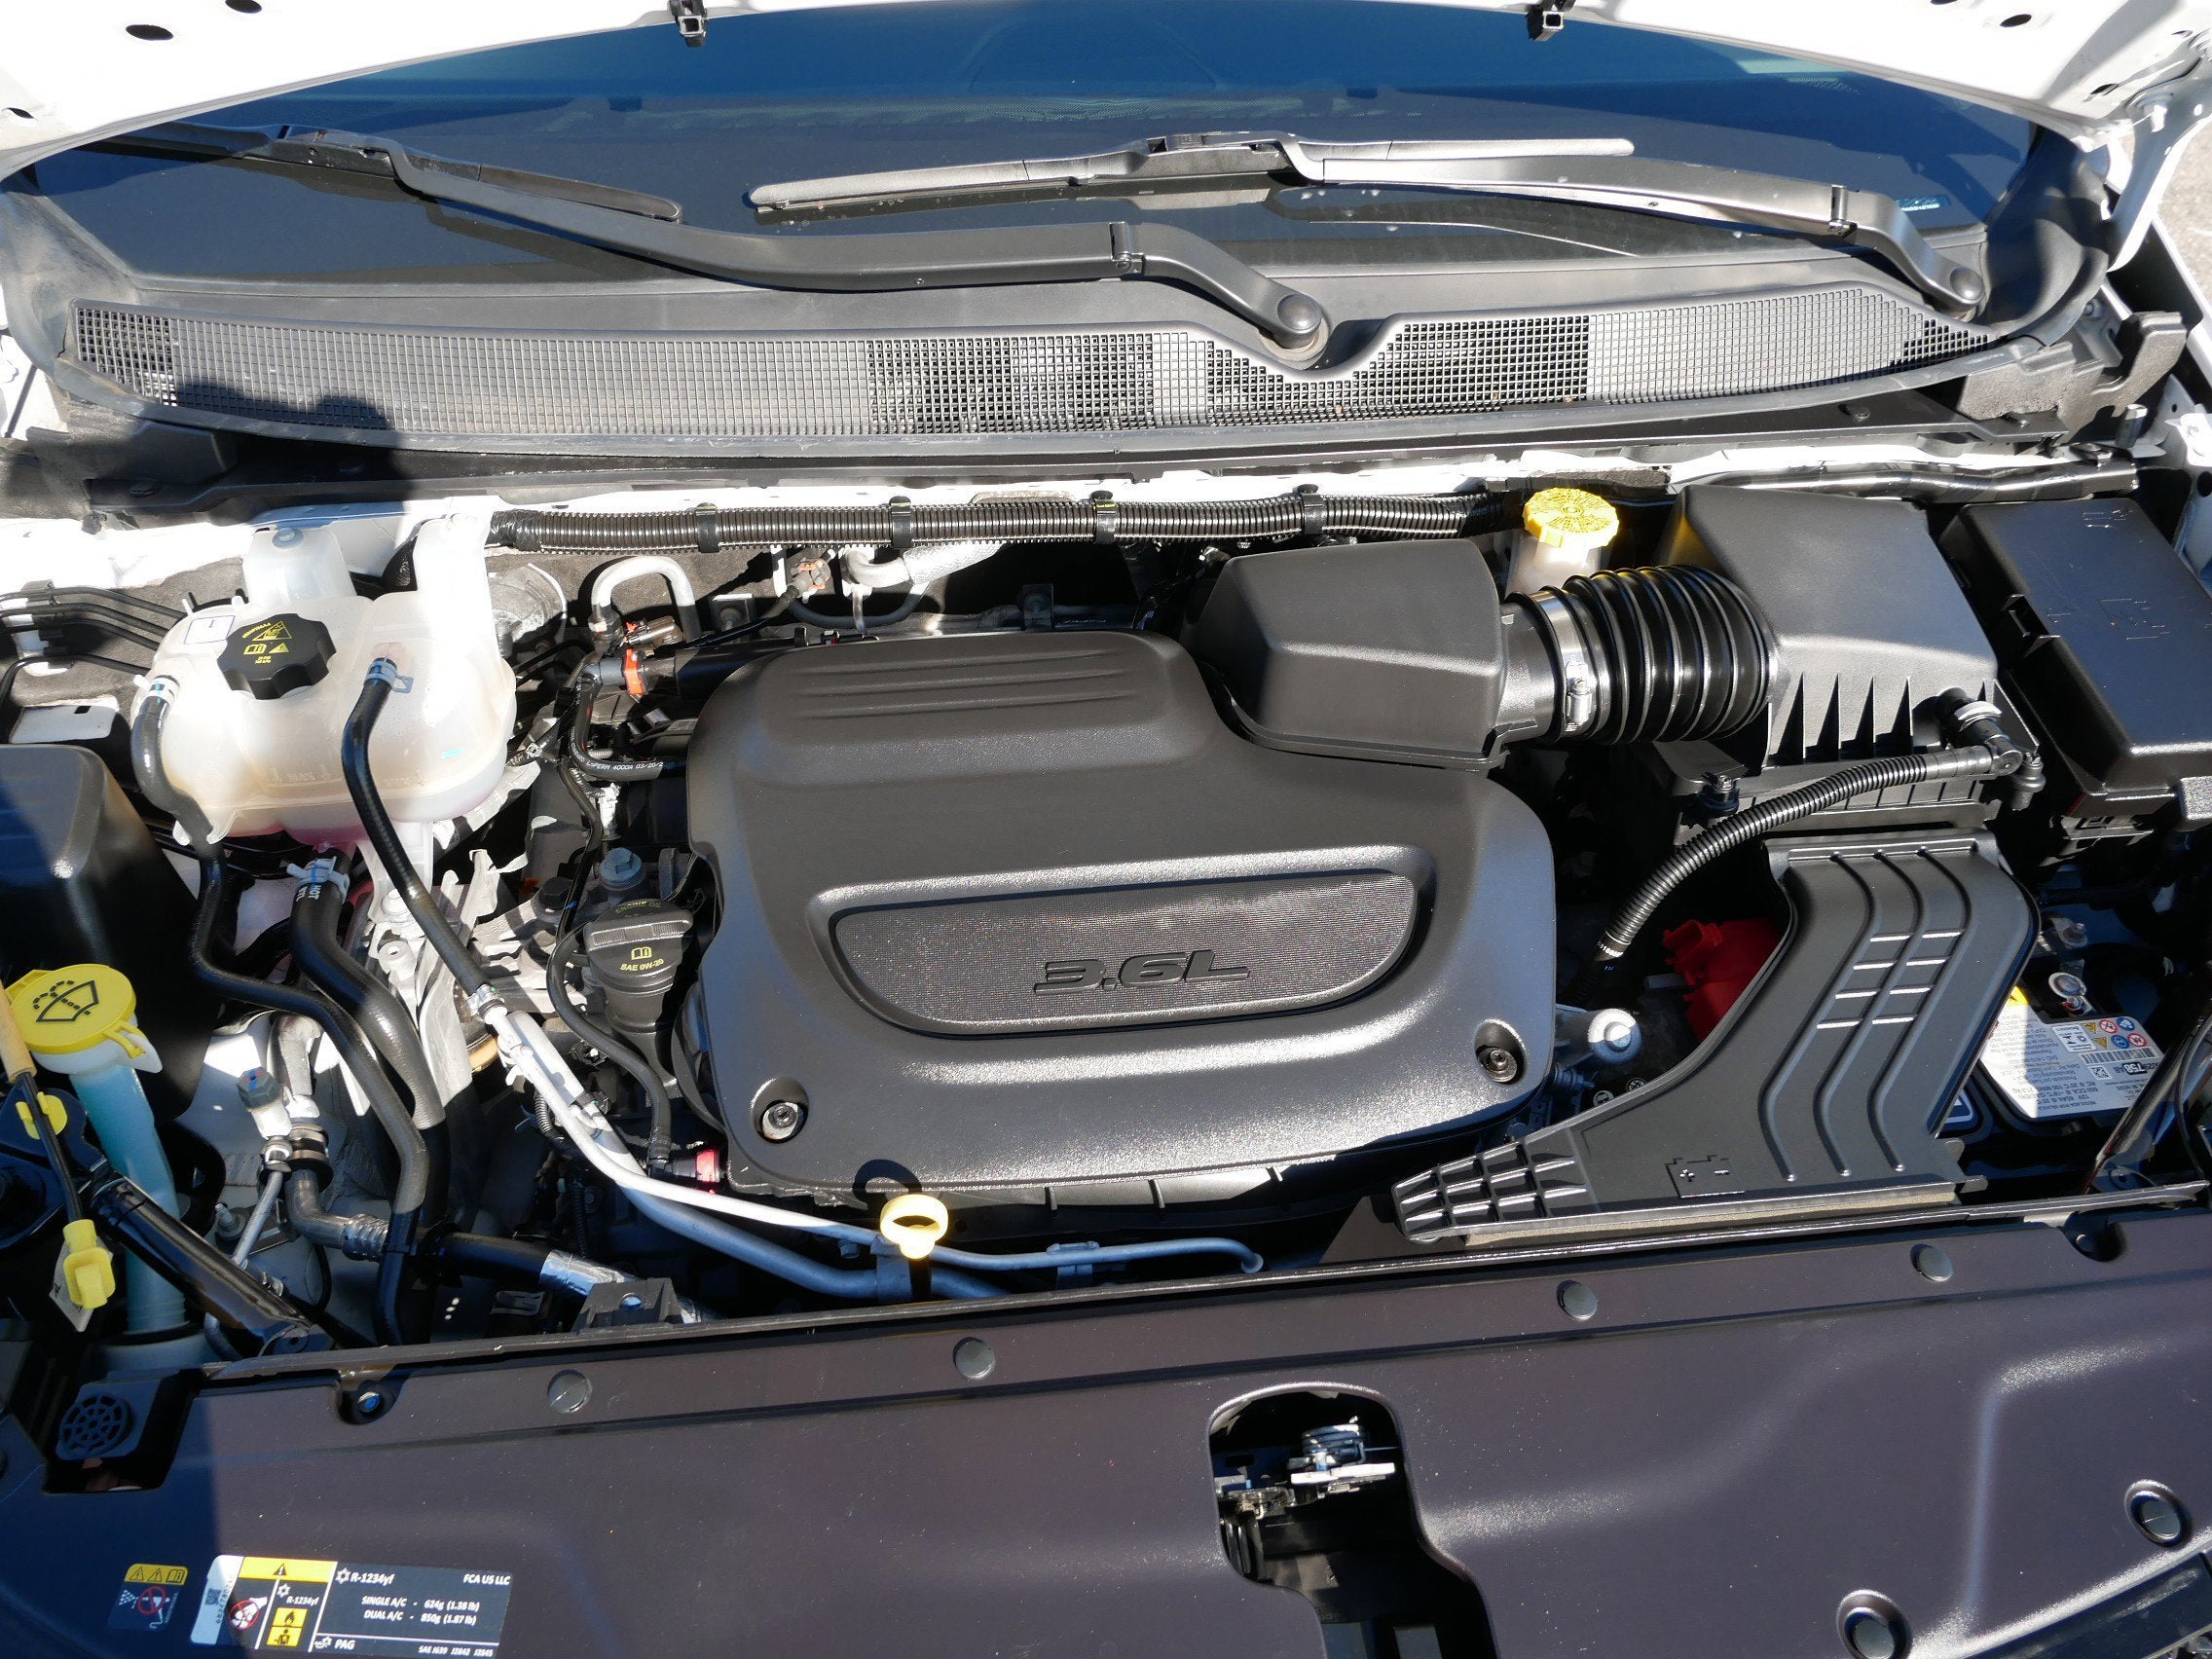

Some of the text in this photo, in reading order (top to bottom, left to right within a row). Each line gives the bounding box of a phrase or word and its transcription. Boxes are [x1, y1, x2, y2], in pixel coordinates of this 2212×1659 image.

[614, 901, 647, 914] ENGINE
[620, 958, 665, 972] SAE 0W-20
[1033, 948, 1250, 995] 3.6L
[350, 1571, 511, 1586] R-1234yf FCA US LLC
[286, 1596, 320, 1606] R-1234yf
[361, 1596, 390, 1606] SINGLE
[389, 1598, 407, 1608] A/C
[424, 1600, 445, 1611] 624g
[446, 1601, 467, 1611] (1.38
[467, 1601, 480, 1612] lb)
[363, 1609, 387, 1620] DUAL
[387, 1610, 404, 1622] A/C
[420, 1612, 441, 1625] 850g
[464, 1614, 477, 1627] lb)
[334, 1639, 355, 1650] PAG
